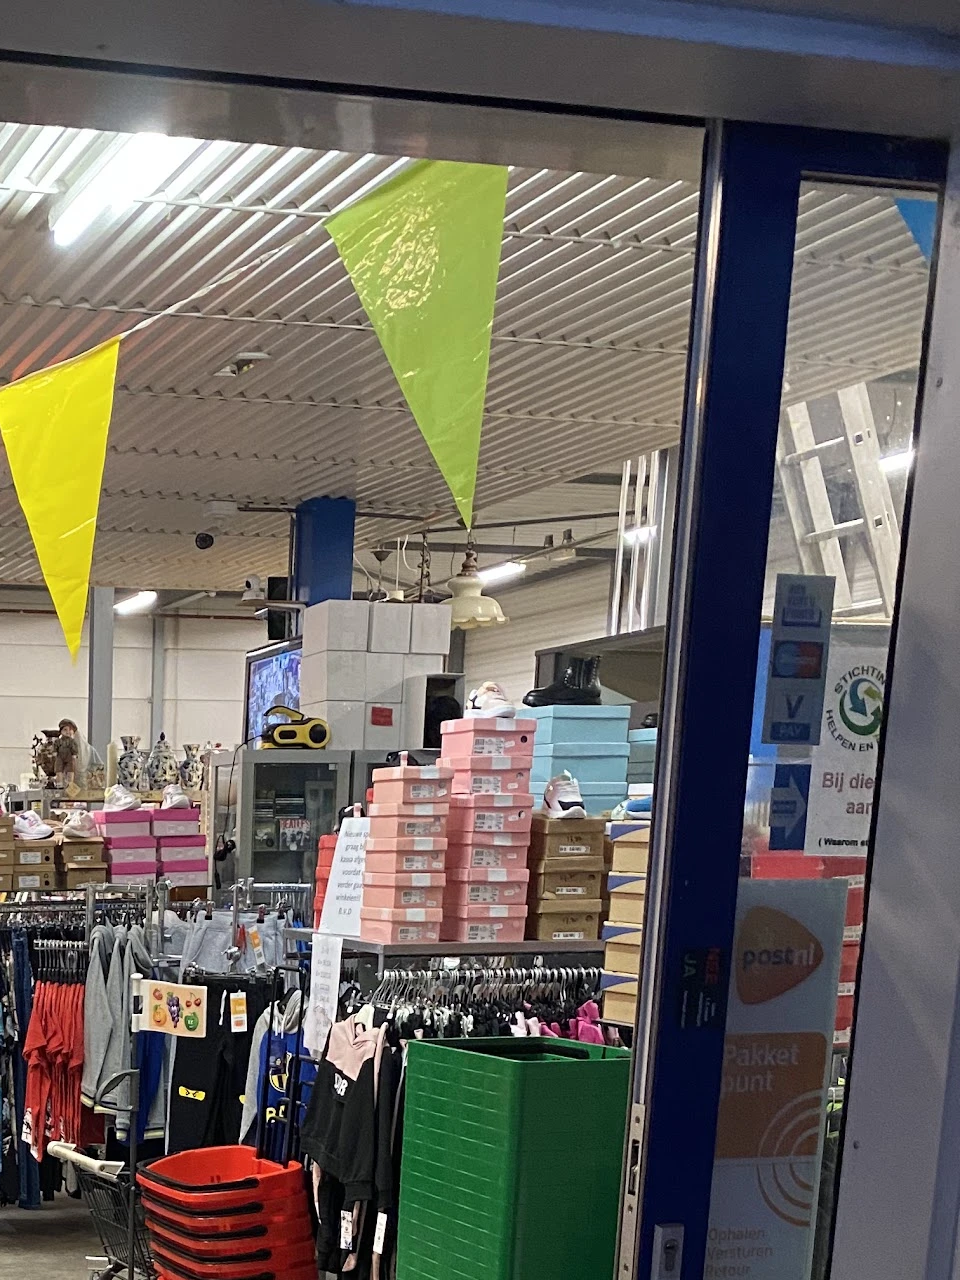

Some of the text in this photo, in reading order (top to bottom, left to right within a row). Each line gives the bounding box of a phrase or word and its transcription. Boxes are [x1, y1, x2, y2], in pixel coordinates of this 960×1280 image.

[825, 709, 873, 752] HELPEN EN
[822, 772, 844, 792] Bij
[824, 838, 859, 847] Waarom
[683, 953, 697, 978] JA
[725, 1042, 800, 1066] Pakket
